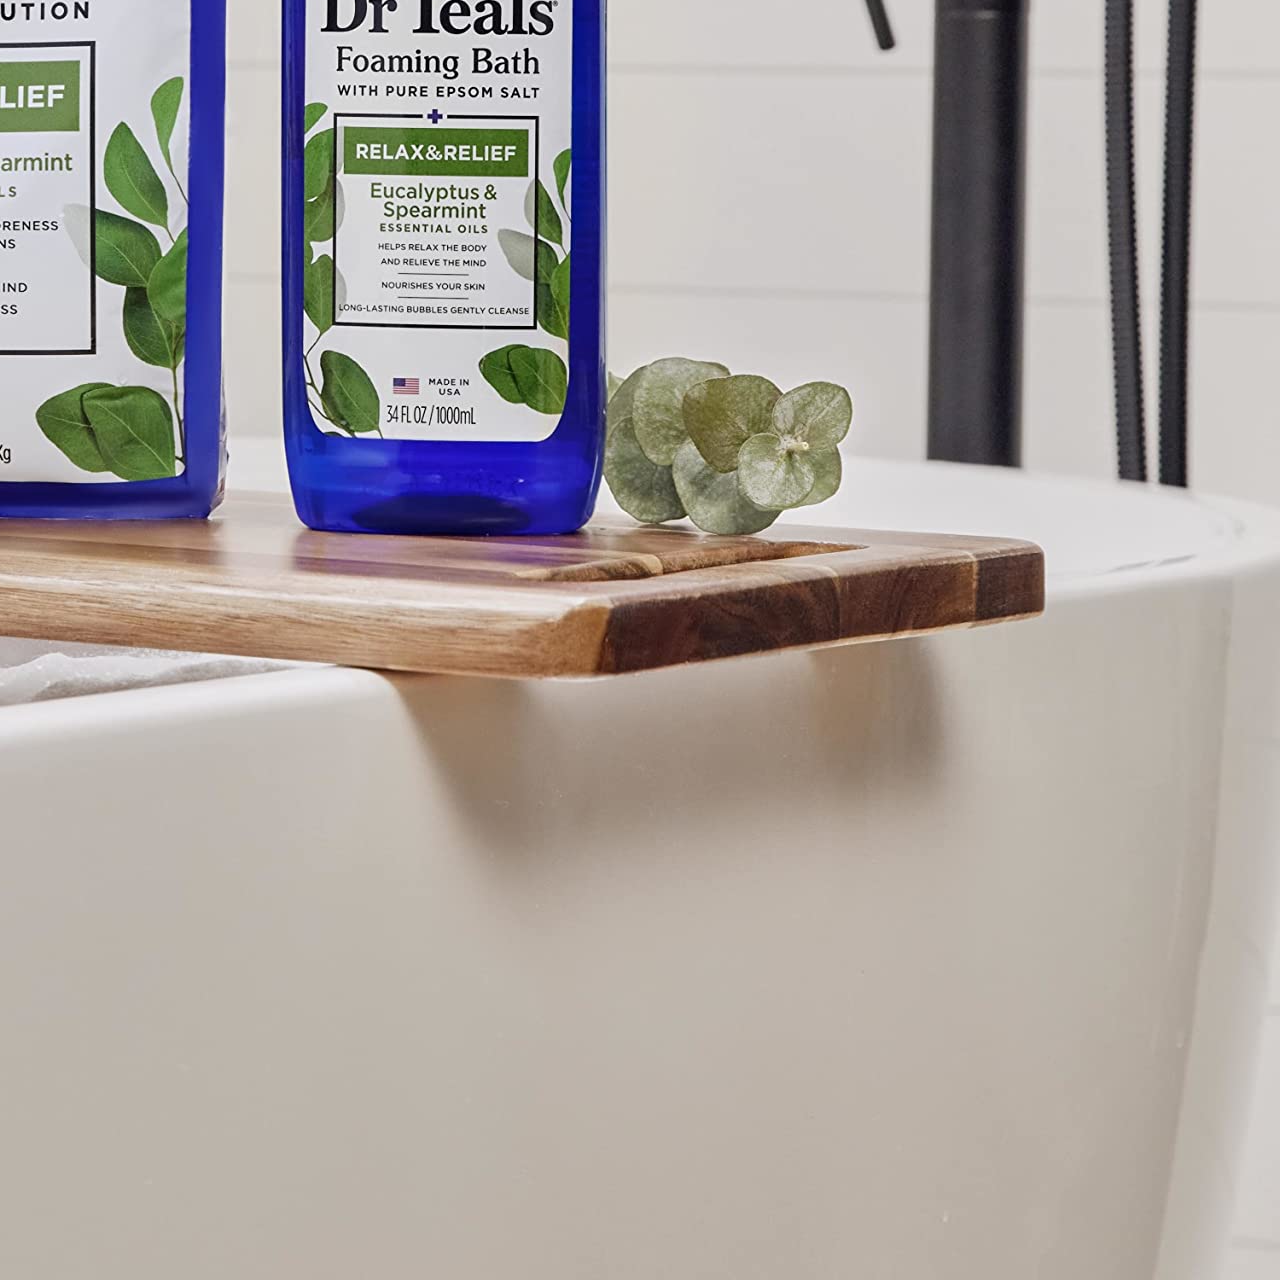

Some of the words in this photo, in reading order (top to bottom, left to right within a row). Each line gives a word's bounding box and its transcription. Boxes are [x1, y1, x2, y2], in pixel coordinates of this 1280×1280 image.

[336, 46, 459, 80] Foaming
[471, 47, 540, 75] Bath
[337, 85, 378, 97] WITH
[386, 85, 428, 97] PURE
[436, 86, 493, 98] EPSOM
[500, 87, 540, 99] SALT
[370, 182, 480, 202] Eucalyptus
[483, 185, 497, 200] &
[383, 200, 486, 221] Spearmint
[380, 223, 451, 233] ESSENTIAL
[458, 224, 488, 234] OILS
[378, 243, 406, 251] HELPS
[408, 243, 439, 252] RELAX
[441, 243, 459, 252] THE
[461, 244, 488, 252] BODY
[381, 258, 401, 266] AND
[402, 258, 441, 266] RELIEVE
[443, 258, 461, 266] THE
[463, 259, 487, 267] MIND
[381, 281, 434, 290] NOURISHES
[435, 281, 462, 290] YOUR
[463, 282, 485, 291] SKIN
[339, 304, 405, 313] LONG-LASTING
[406, 305, 448, 314] BUBBLES
[450, 306, 486, 315] GENTLY
[488, 307, 530, 315] CLEANSE
[428, 378, 456, 386] MADE
[459, 378, 470, 386] IN
[438, 388, 460, 396] USA
[386, 405, 399, 423] 34
[401, 405, 411, 423] FL
[413, 406, 427, 424] OZ
[436, 406, 476, 425] 1000mL
